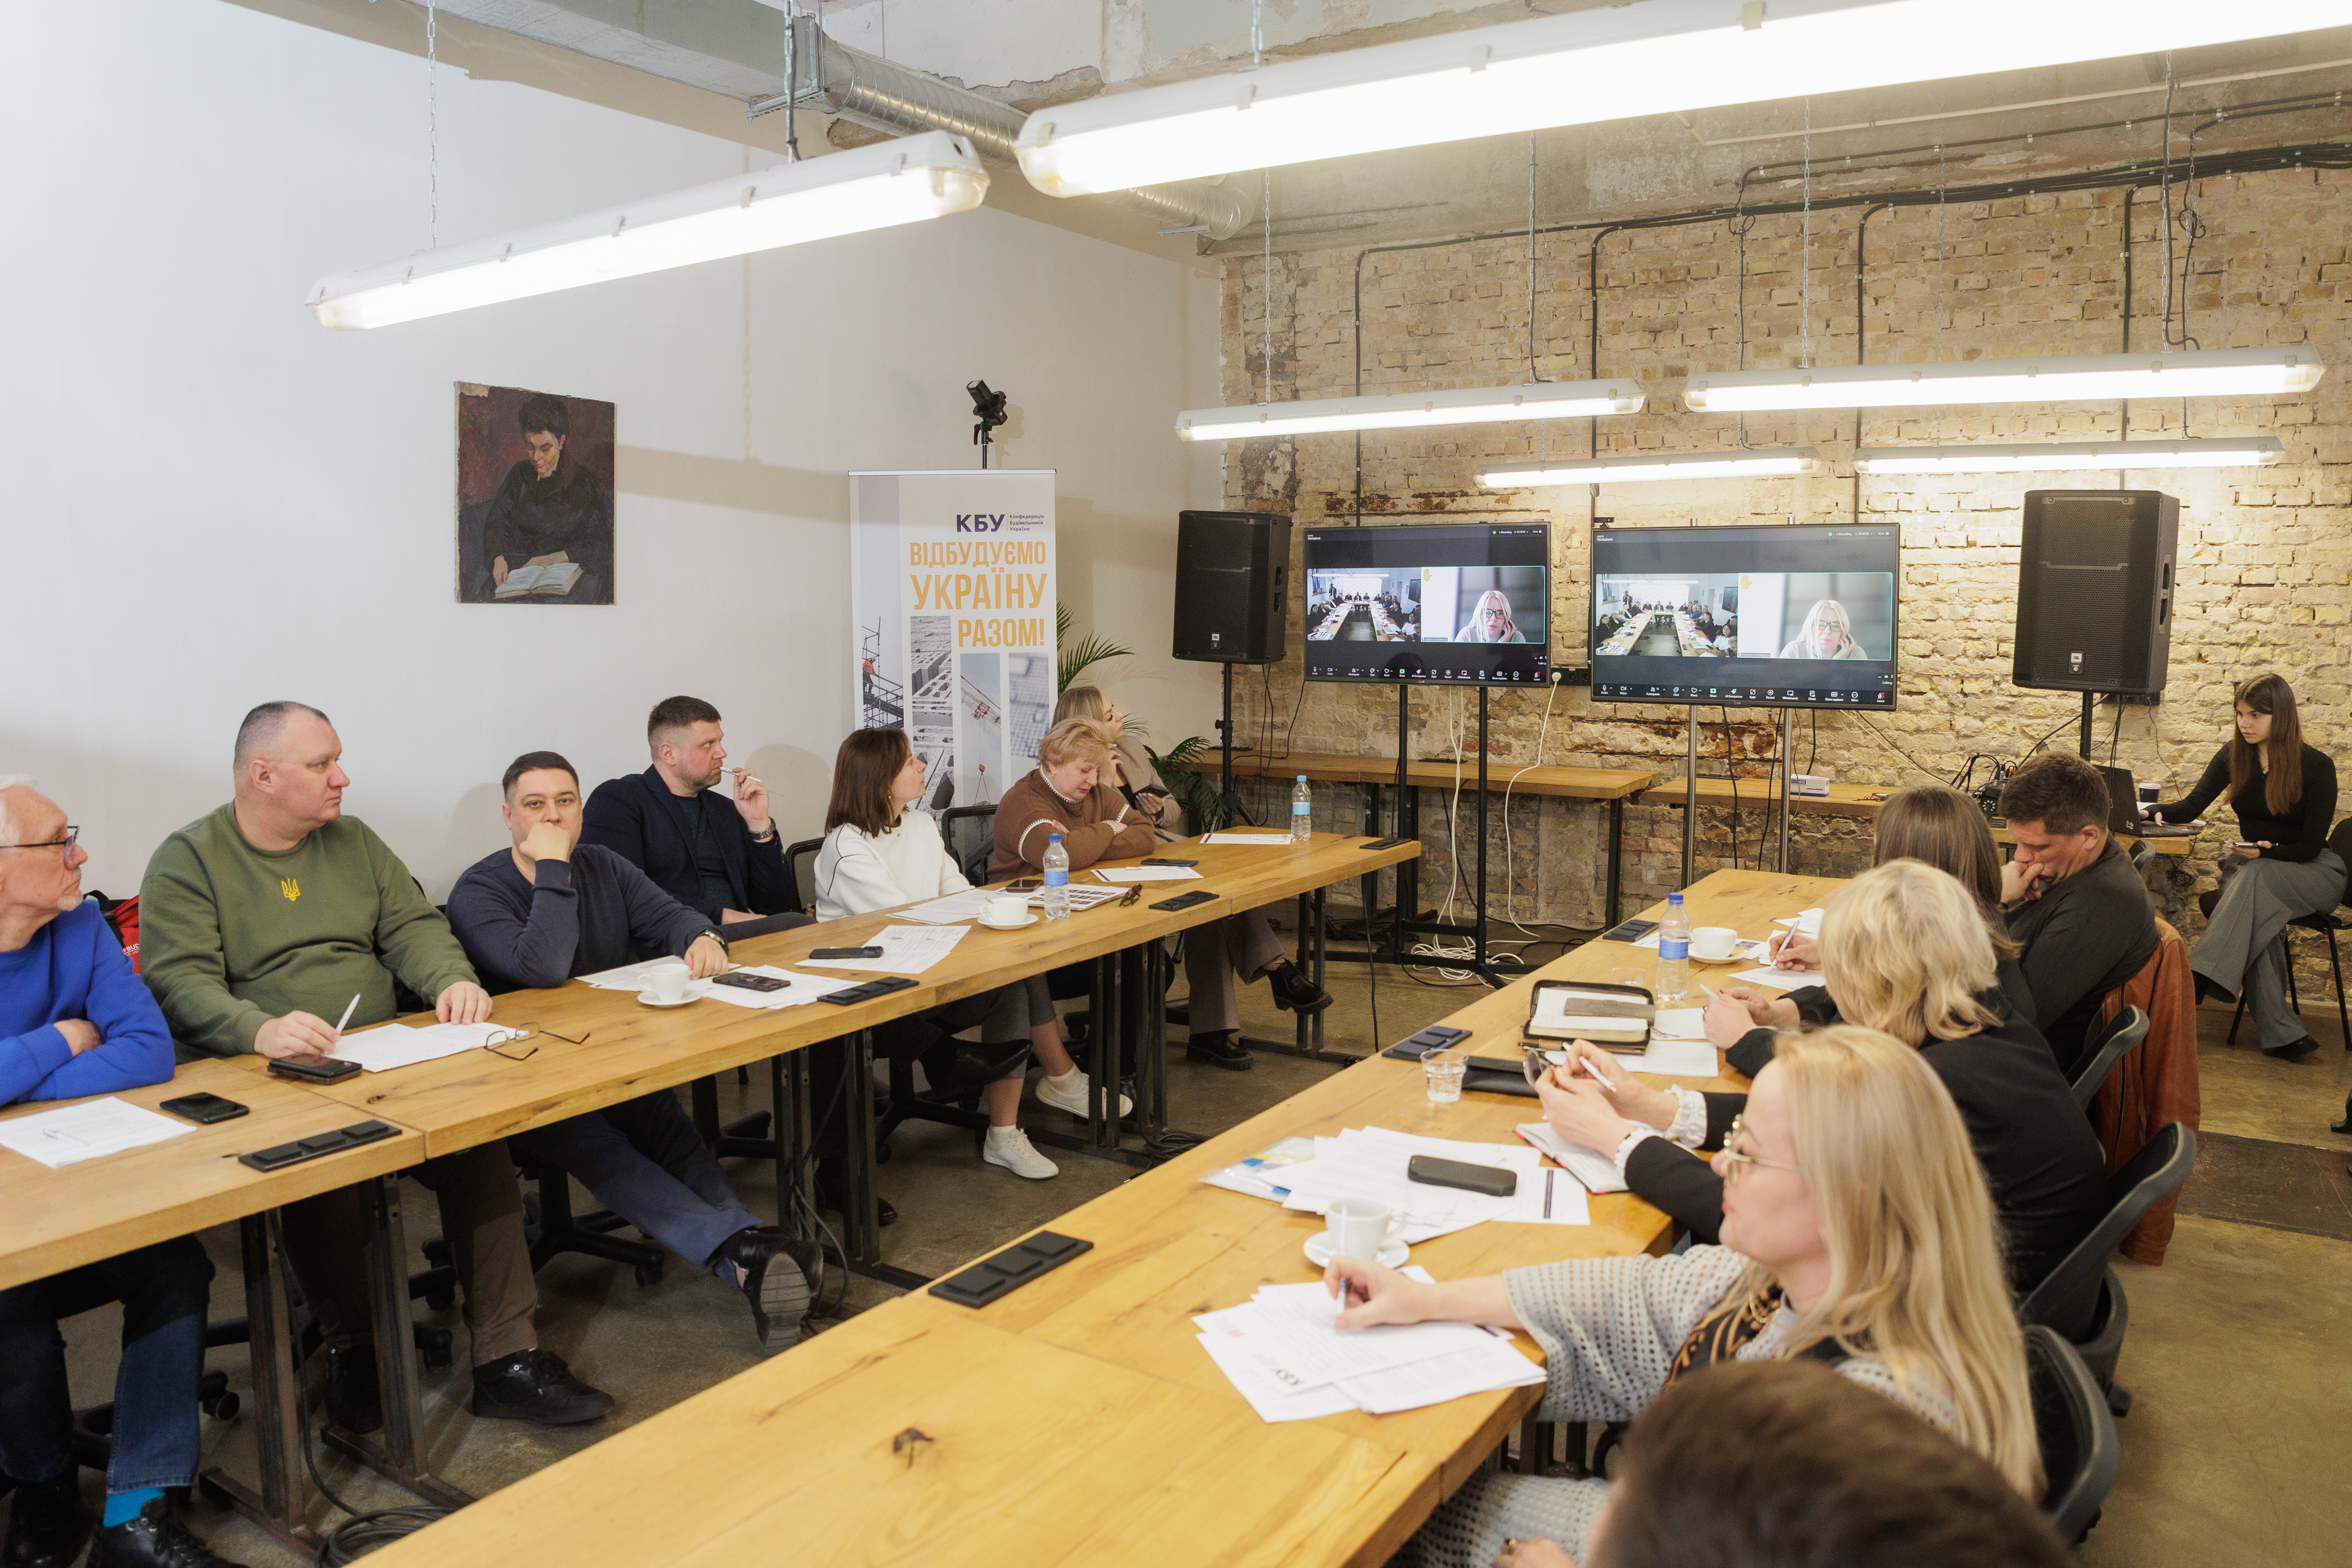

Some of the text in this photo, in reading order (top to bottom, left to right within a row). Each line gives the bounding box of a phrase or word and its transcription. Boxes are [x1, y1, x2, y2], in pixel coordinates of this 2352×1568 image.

[956, 514, 1006, 533] КБУ
[910, 541, 1046, 568] ВІДБУДУЄМО
[910, 567, 1047, 610] УКРАЇНУ
[958, 618, 1044, 647] РАЗОМ!
[122, 943, 140, 953] FBUD
